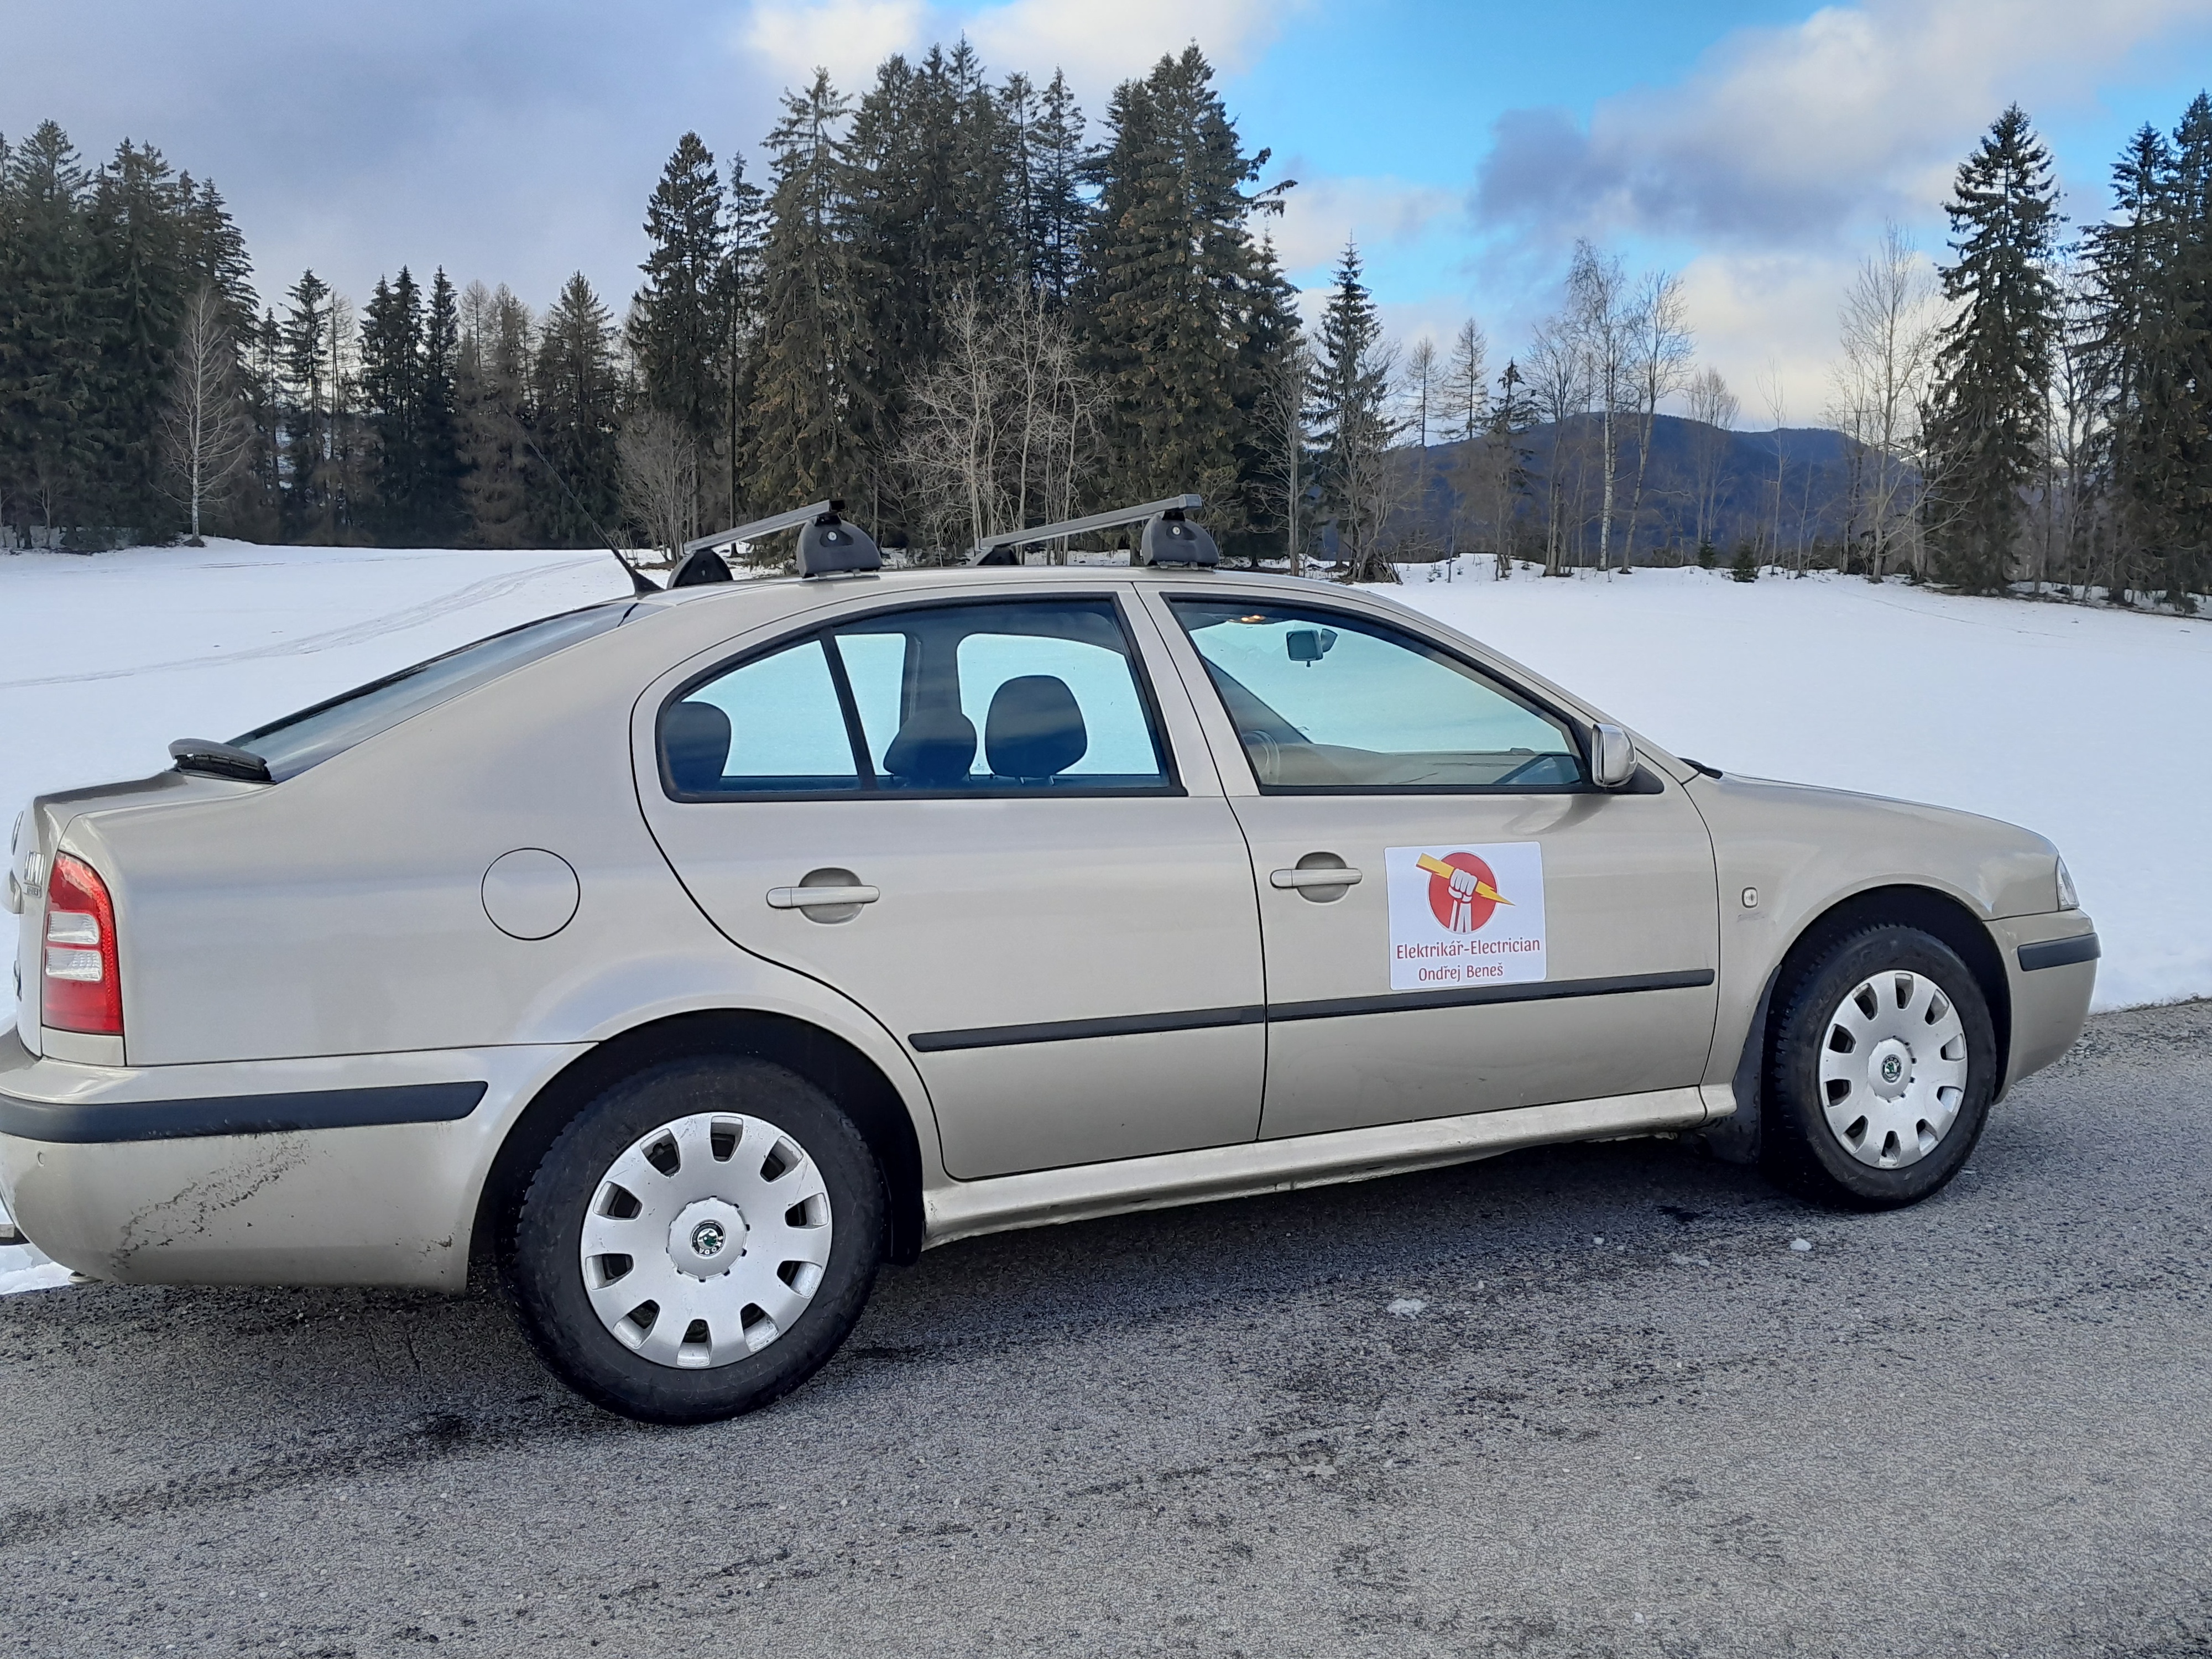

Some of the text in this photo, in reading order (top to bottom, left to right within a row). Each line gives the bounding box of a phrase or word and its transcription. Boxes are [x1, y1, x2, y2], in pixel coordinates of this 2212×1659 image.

[1397, 937, 1540, 959] Elektrikář-Electrician
[1418, 962, 1504, 982] Ondřej Beneš
